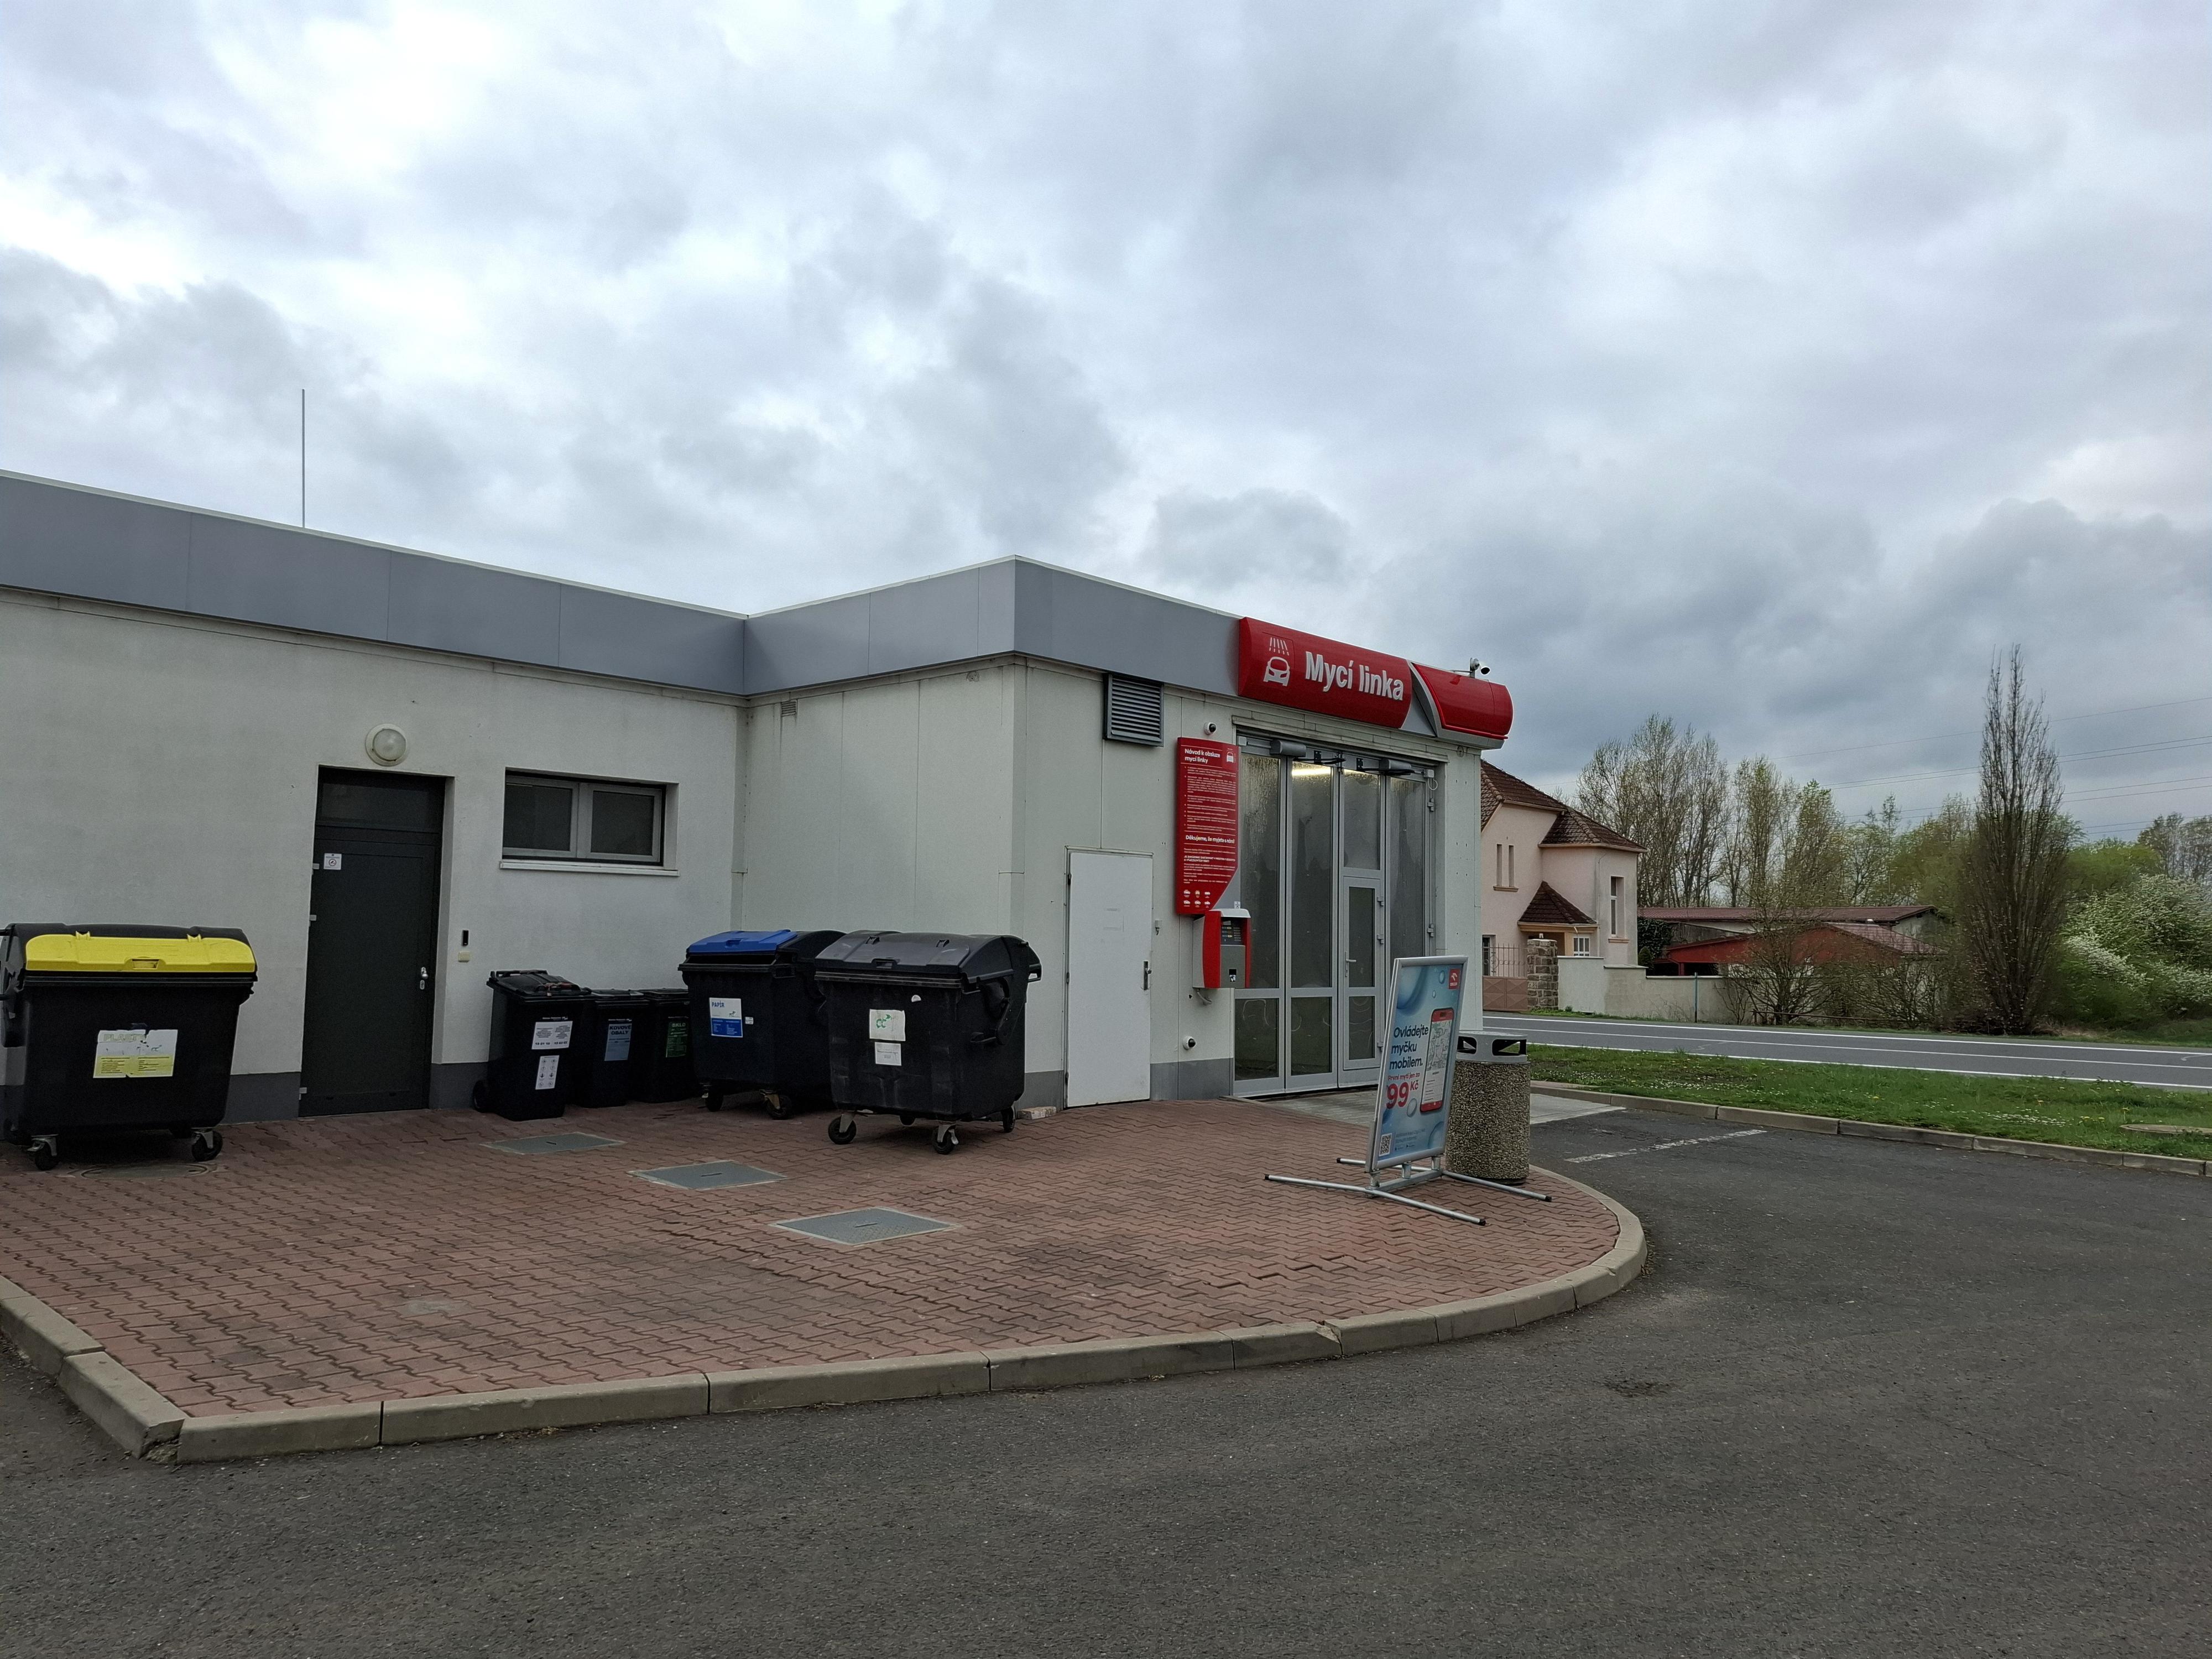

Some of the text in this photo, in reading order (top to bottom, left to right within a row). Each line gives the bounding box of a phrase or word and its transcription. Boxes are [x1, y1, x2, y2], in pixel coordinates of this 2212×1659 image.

[1305, 651, 1404, 701] Mycí linka
[1394, 1024, 1429, 1039] Ovládejte
[1391, 1040, 1417, 1056] myčku
[1389, 1056, 1423, 1070] mobilem.
[1386, 1082, 1409, 1109] 99
[1410, 1079, 1419, 1091] Kč
